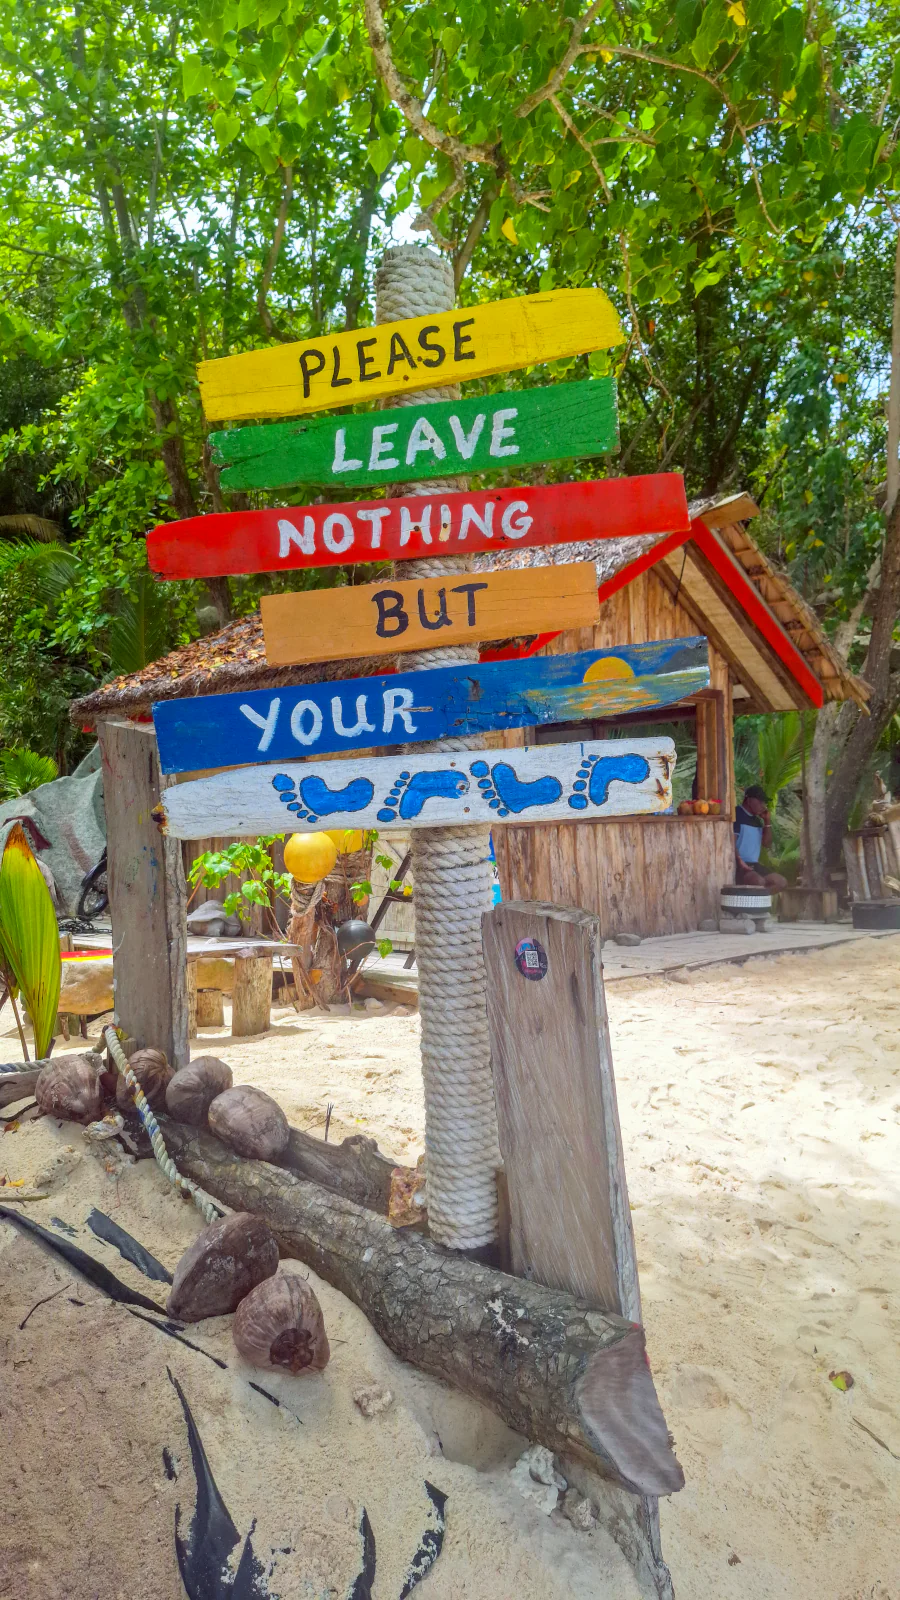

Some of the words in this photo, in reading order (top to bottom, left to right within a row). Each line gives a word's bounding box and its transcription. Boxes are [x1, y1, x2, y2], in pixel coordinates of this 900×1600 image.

[299, 317, 476, 399] PLEASE
[331, 408, 520, 474] LEAVE
[277, 500, 534, 558] NOTHING
[371, 582, 489, 638] BUT
[239, 687, 418, 752] YOUR
